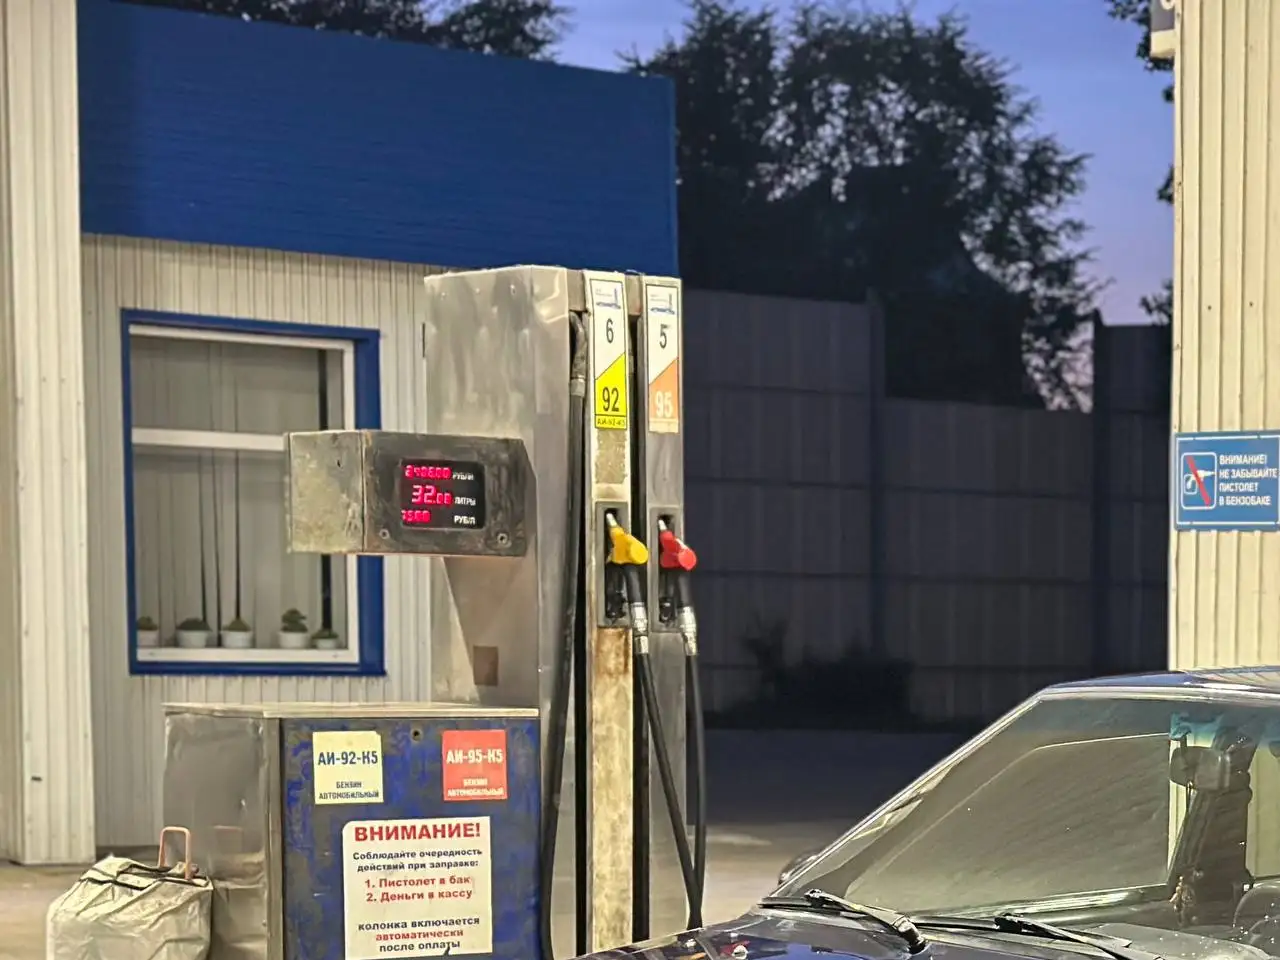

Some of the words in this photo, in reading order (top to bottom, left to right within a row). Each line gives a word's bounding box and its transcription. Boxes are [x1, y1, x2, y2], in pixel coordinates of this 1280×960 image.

[605, 318, 614, 343] 6
[659, 324, 668, 348] 5
[602, 387, 620, 411] 92
[656, 391, 673, 417] 95
[1219, 468, 1229, 478] НЕ
[1219, 482, 1258, 492] ПИСТОЛЕТ
[412, 485, 454, 505] 32.00
[455, 497, 476, 505] ЛИТРЫ
[1219, 496, 1224, 505] В
[1226, 495, 1271, 505] БЕНЗОБАКЕ
[319, 790, 379, 800] АВТОМОБИЛЬНЫЙ
[354, 822, 481, 842] ВНИМАНИЕ!
[353, 850, 416, 860] Соблюдайте
[419, 848, 482, 858] очередность
[357, 861, 405, 872] действий
[407, 863, 426, 871] при
[429, 860, 479, 869] заправке:
[365, 879, 376, 888] 1.
[379, 877, 436, 888] Пистолет
[449, 875, 471, 884] бак
[366, 893, 377, 902] 2.
[380, 891, 424, 903] Деньги
[428, 891, 434, 899] в
[438, 889, 472, 899] кассу
[358, 922, 408, 931] колонка
[411, 917, 480, 928] включается
[375, 929, 464, 941] автоматически
[379, 942, 415, 952] после
[418, 940, 460, 950] оплаты
